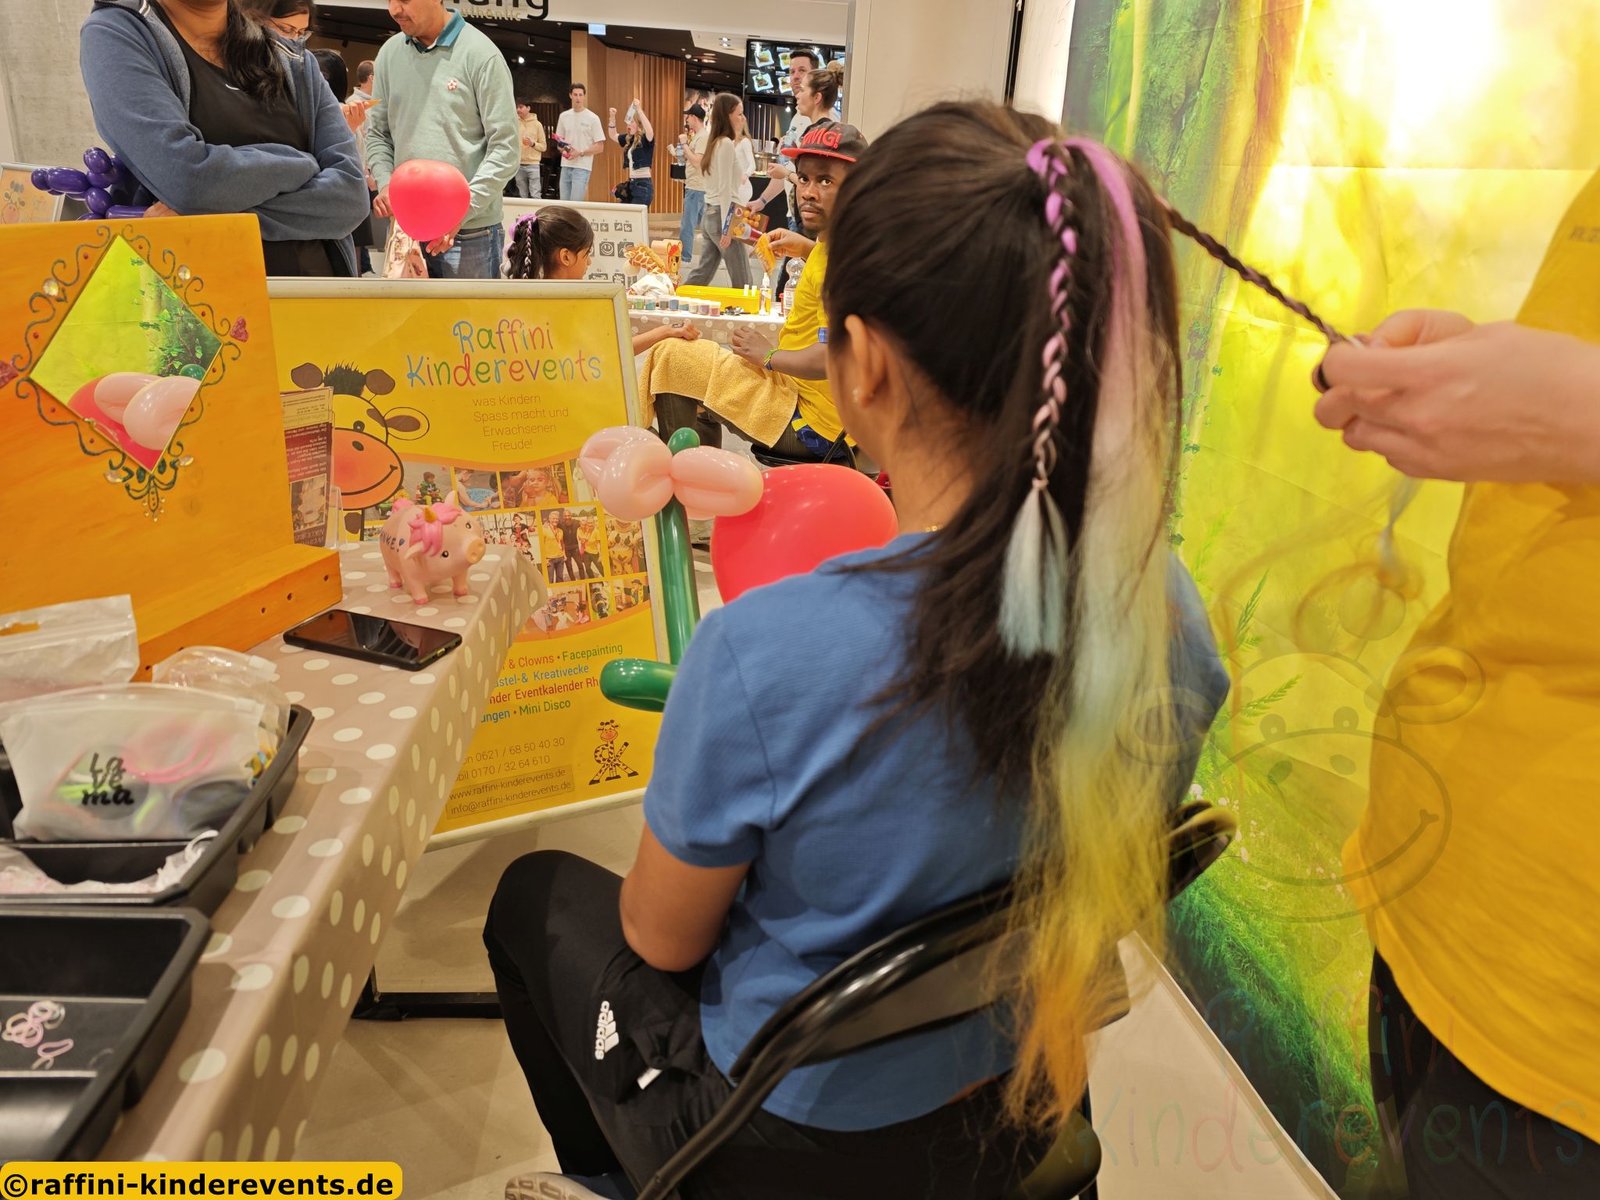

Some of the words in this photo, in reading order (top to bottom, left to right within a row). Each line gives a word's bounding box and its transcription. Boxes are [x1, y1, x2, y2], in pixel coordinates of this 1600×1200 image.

[453, 319, 553, 353] Raffini
[406, 350, 601, 387] Kinderevents
[472, 397, 496, 407] was
[498, 394, 541, 406] Kindern
[473, 410, 509, 423] Spass
[511, 408, 546, 420] macht
[548, 407, 569, 418] und
[482, 423, 557, 437] Erwachsenen
[492, 439, 533, 451] Freude!
[518, 655, 554, 668] Clowns
[562, 644, 623, 661] Facepainting
[533, 664, 589, 680] Kreativecke
[489, 691, 511, 704] nder
[515, 680, 583, 700] Eventkalender
[586, 677, 599, 688] Rh
[519, 704, 541, 716] Mini
[544, 699, 571, 712] Disco
[475, 749, 499, 762] 0621
[509, 744, 521, 755] 68
[524, 742, 536, 752] 50
[538, 739, 550, 749] 40
[553, 737, 565, 746] 30
[471, 765, 496, 779] 0170
[504, 761, 516, 772] 32
[518, 758, 530, 769] 64
[532, 754, 551, 766] 610
[449, 768, 567, 800] www.raffini-kinderevents.de
[82, 788, 134, 805] ma
[450, 781, 572, 815] info@raffini-kinderevents.de
